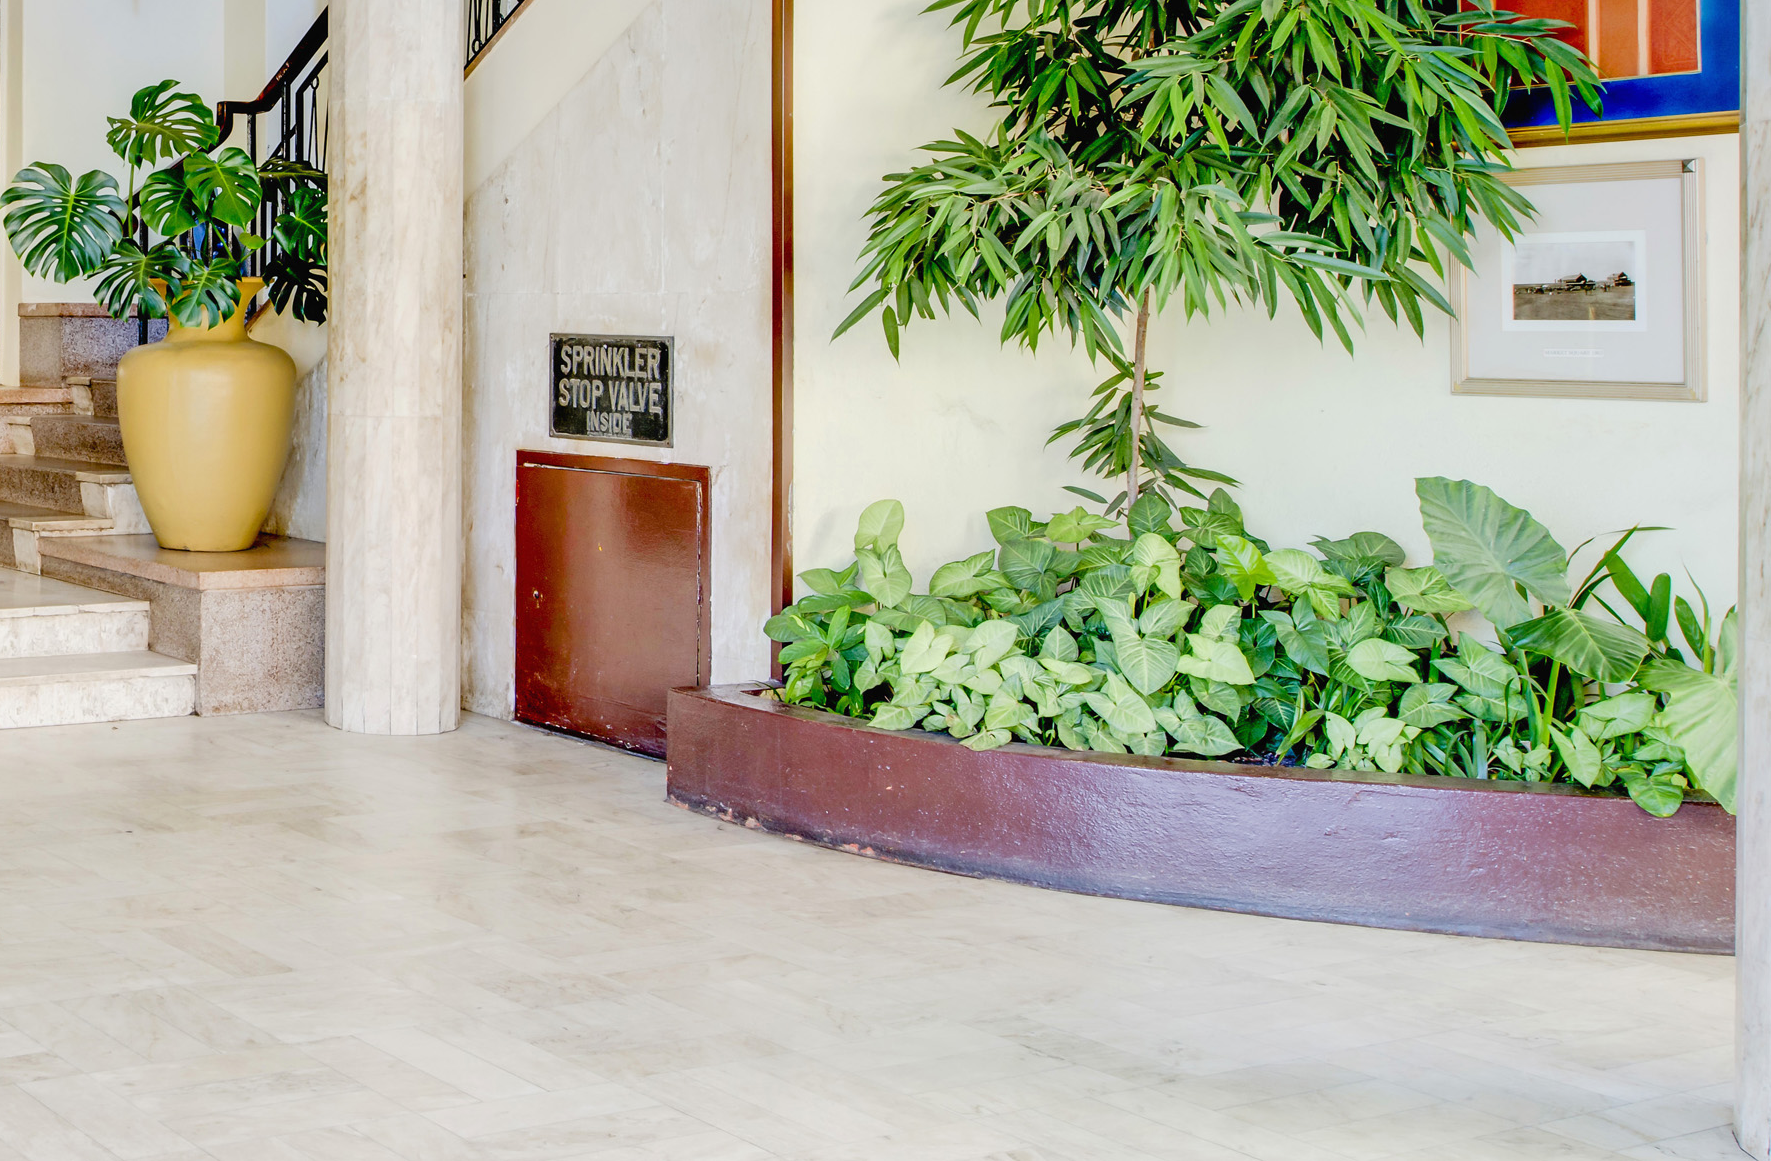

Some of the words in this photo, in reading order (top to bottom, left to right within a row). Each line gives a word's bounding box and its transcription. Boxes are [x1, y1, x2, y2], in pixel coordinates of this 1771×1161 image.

[561, 344, 661, 380] SPRINKLER
[558, 378, 604, 410] STOP
[608, 380, 663, 414] VALVE
[586, 410, 633, 433] INSIDE
